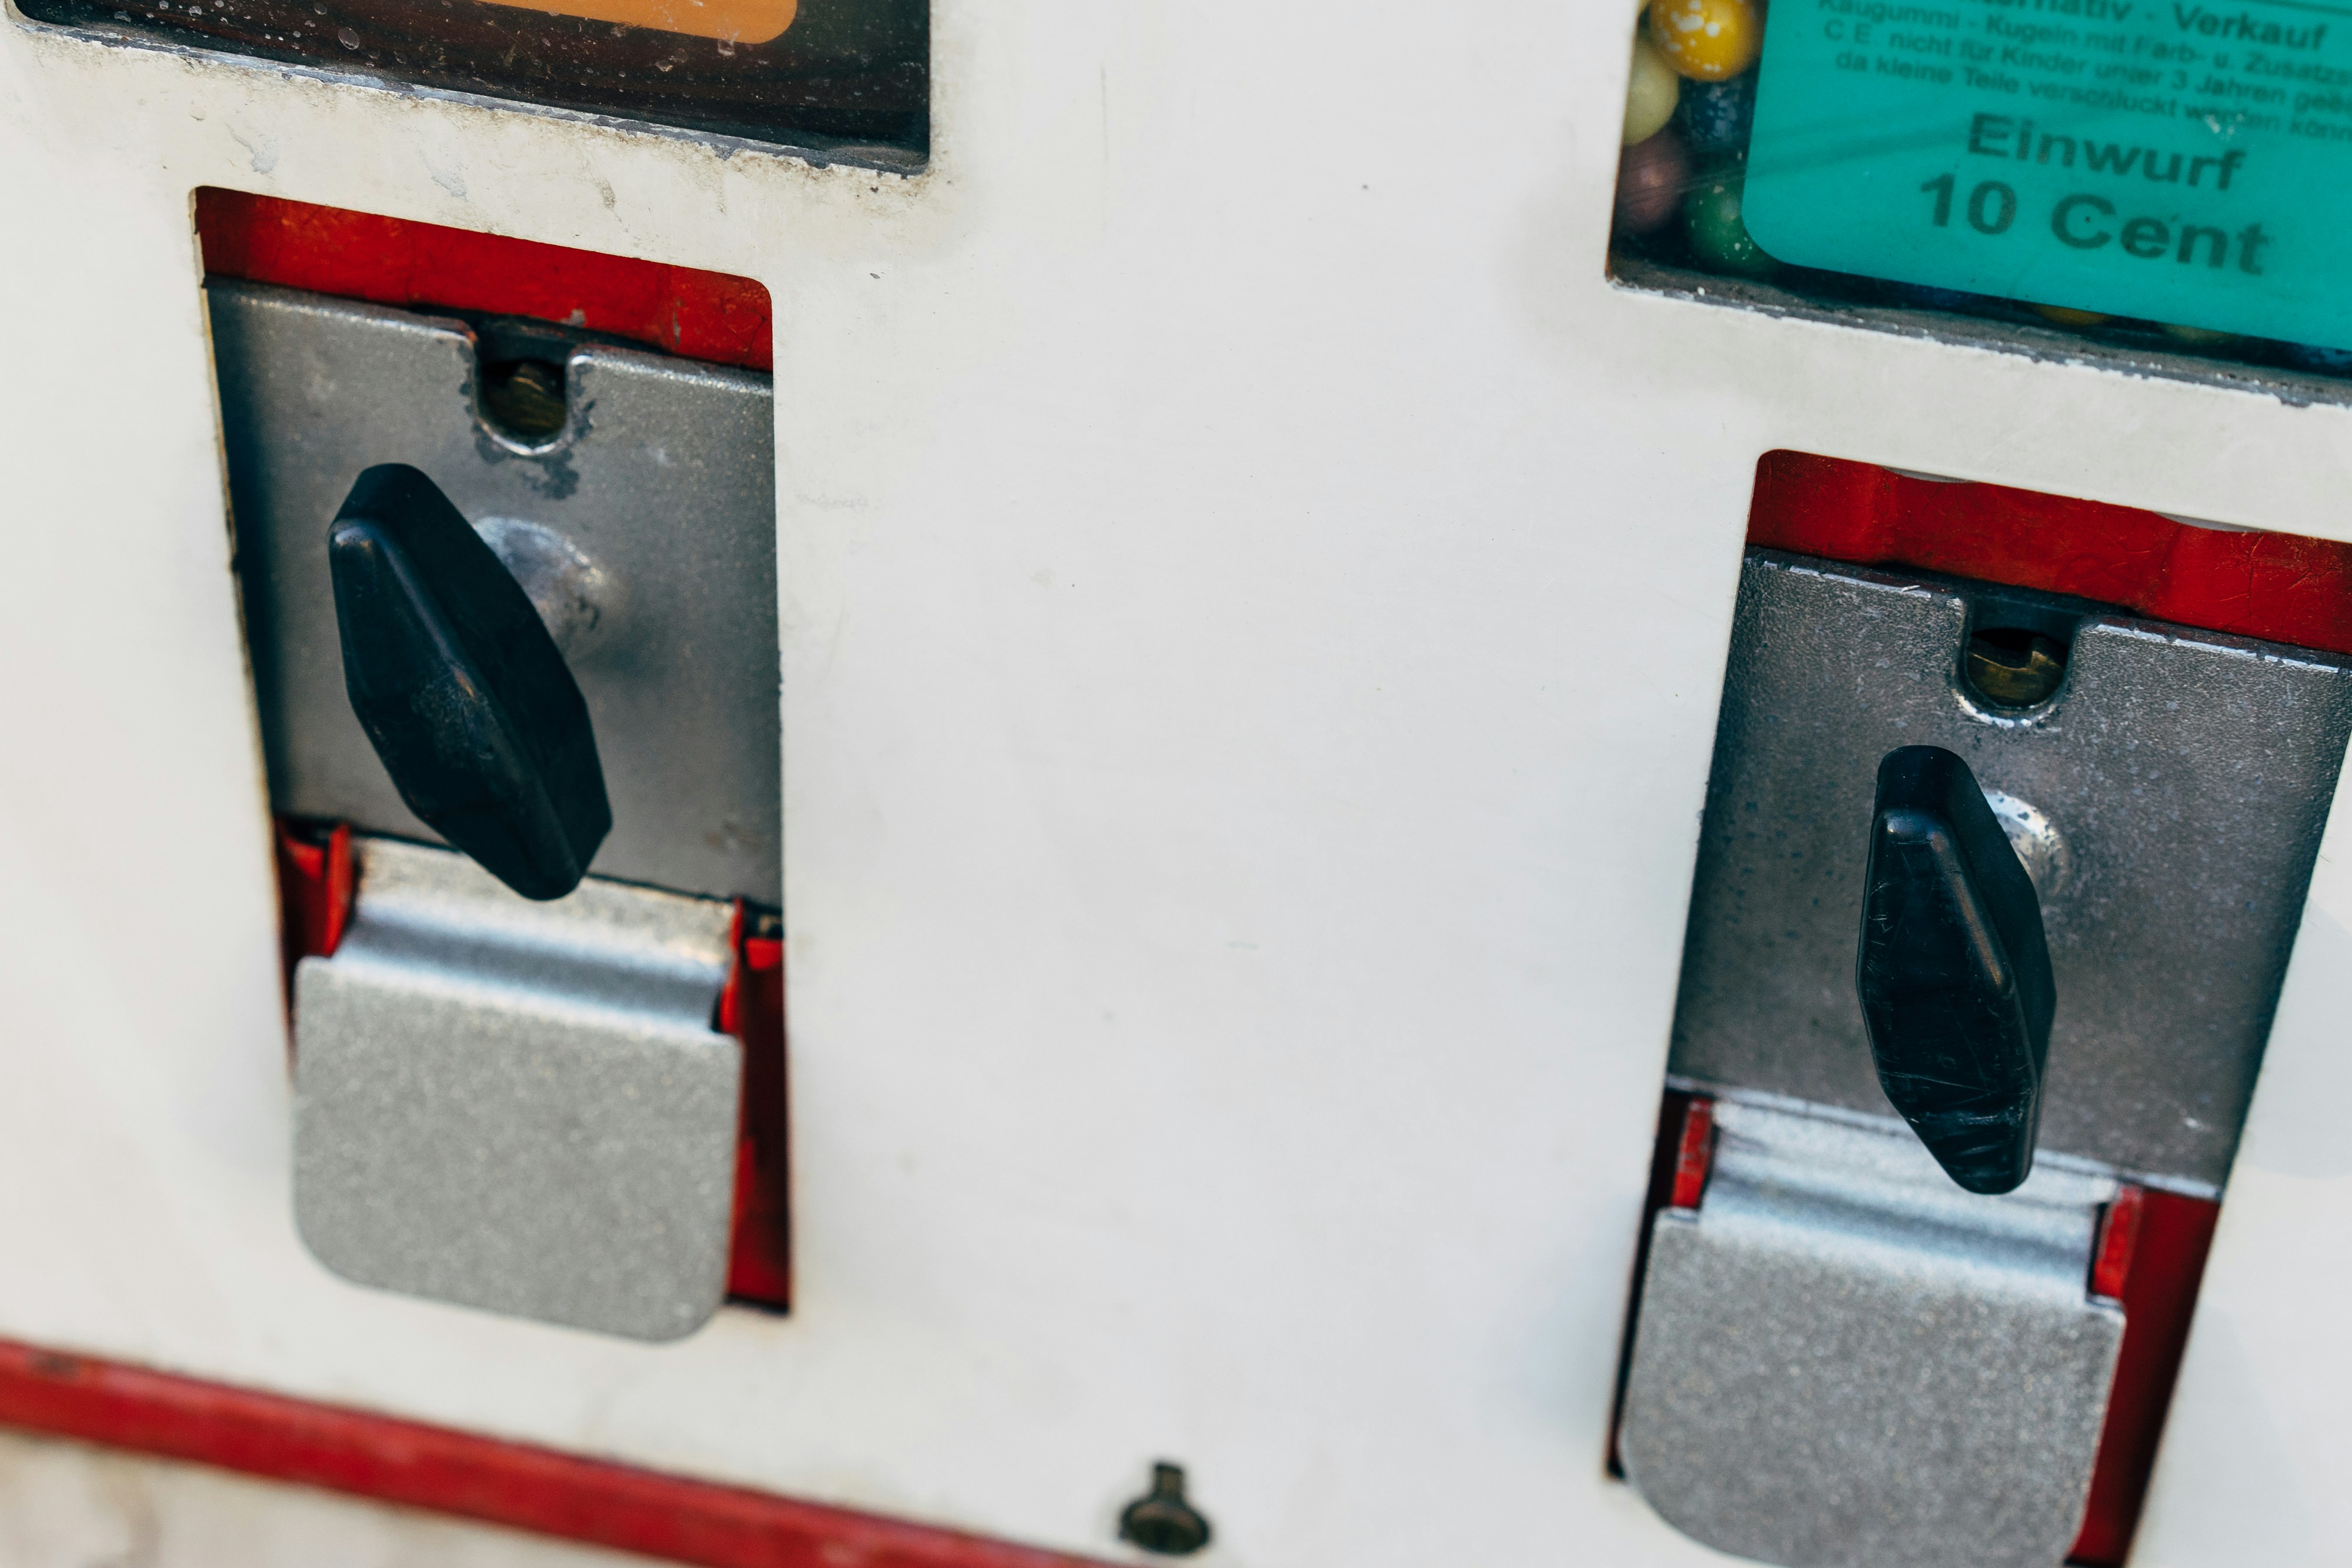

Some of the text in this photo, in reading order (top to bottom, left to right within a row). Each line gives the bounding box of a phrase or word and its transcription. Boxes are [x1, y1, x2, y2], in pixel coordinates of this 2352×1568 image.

[2084, 32, 2127, 54] mit
[2173, 1, 2328, 51] Verkauf
[1835, 50, 1868, 72] da
[1875, 55, 1954, 85] kleine
[1961, 65, 2020, 94] Teile
[1888, 32, 1953, 57] nicht
[2001, 45, 2087, 75] Kinder
[2171, 69, 2188, 91] 3
[2195, 74, 2287, 105] Jahren
[1967, 112, 2247, 191] Einwurf
[1920, 173, 2270, 276] 10 Cent
